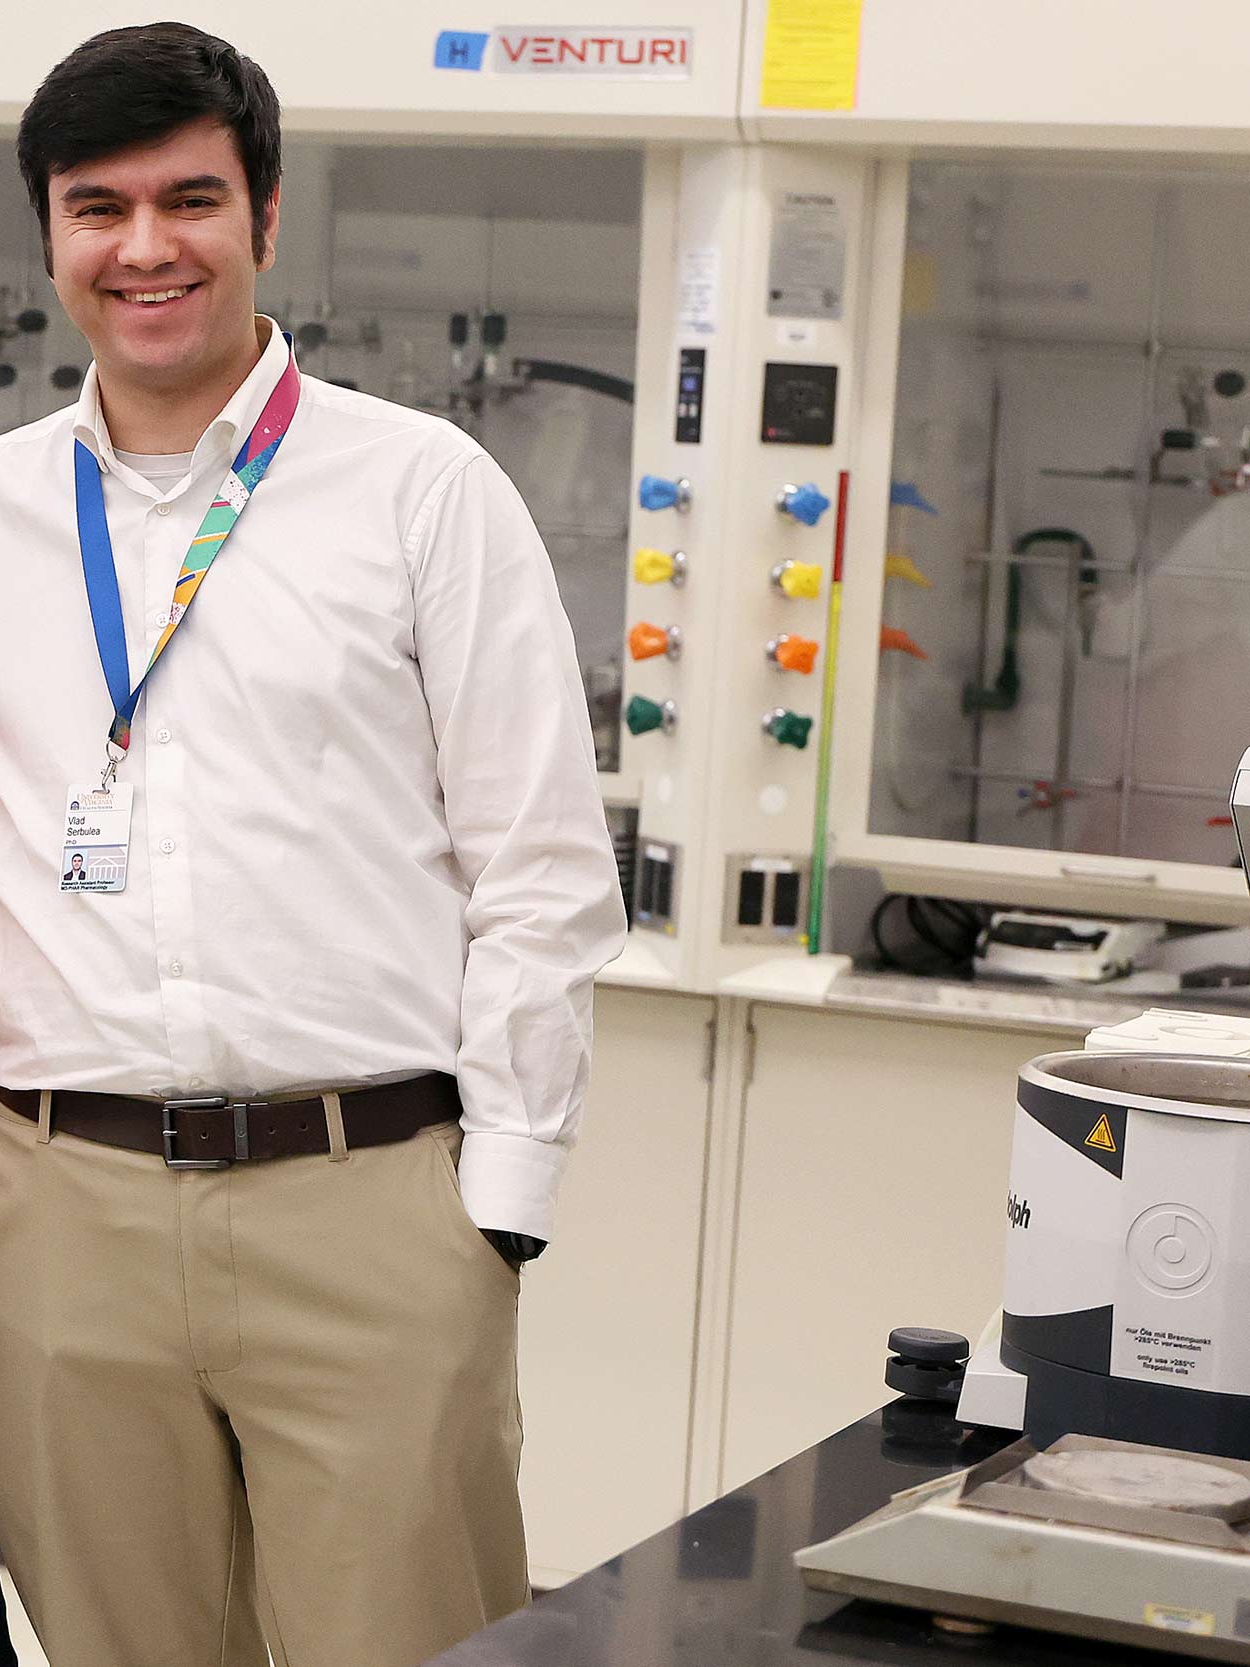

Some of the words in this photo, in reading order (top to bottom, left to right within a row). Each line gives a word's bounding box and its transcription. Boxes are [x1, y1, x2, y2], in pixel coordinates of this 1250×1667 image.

[450, 38, 469, 64] H
[500, 36, 686, 65] VENTURI
[68, 816, 85, 825] Vlad
[66, 826, 101, 836] Serbulea
